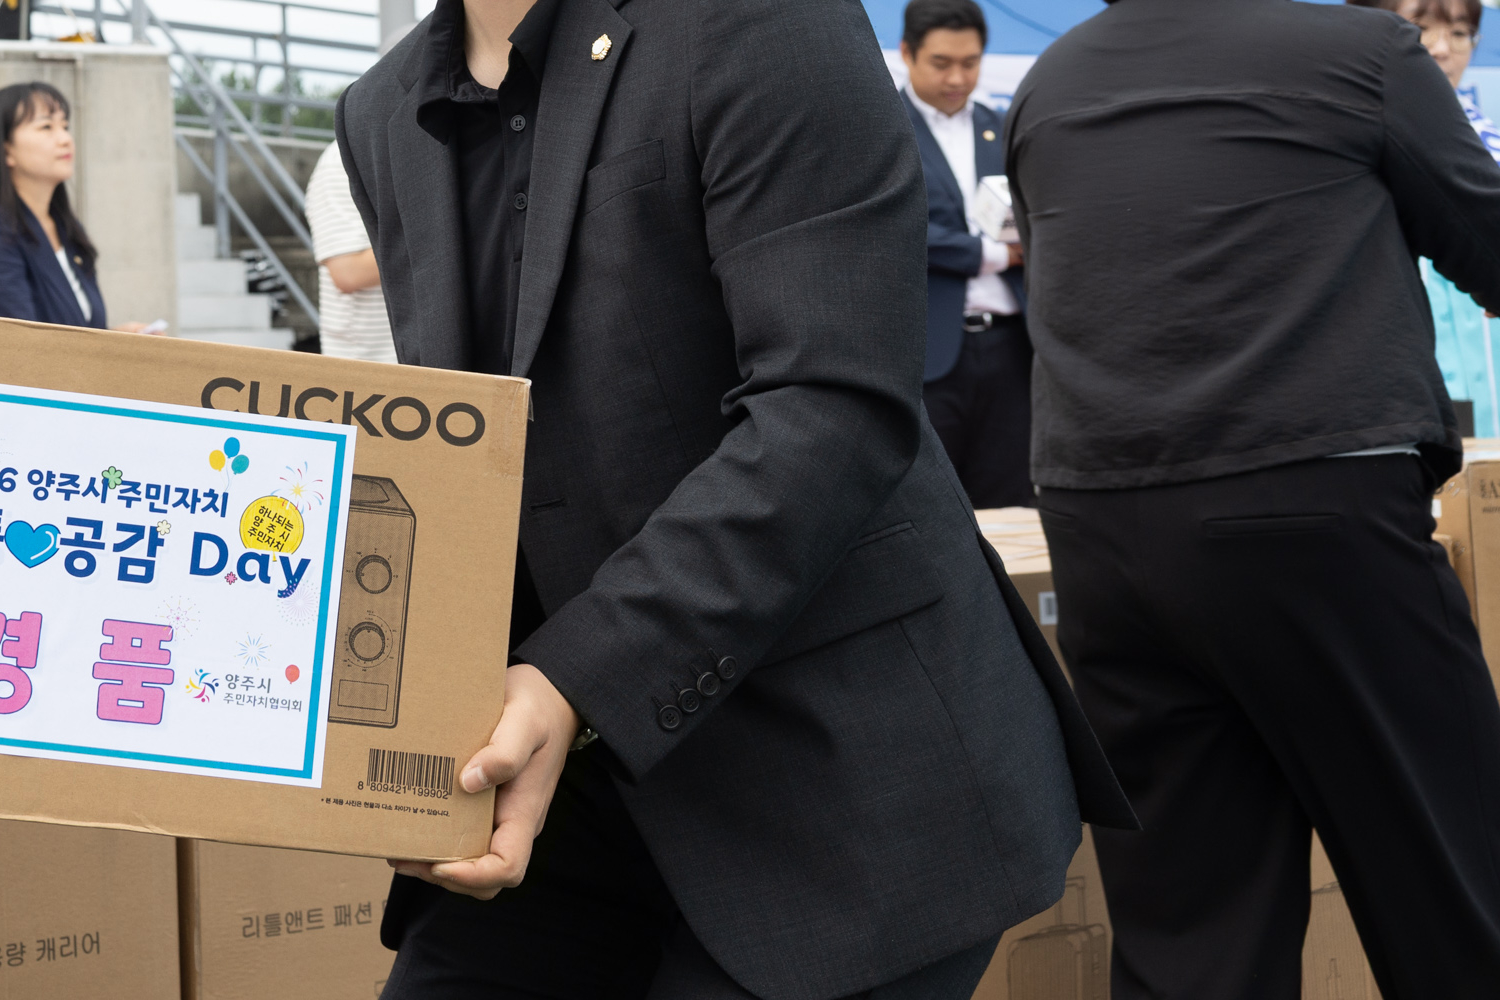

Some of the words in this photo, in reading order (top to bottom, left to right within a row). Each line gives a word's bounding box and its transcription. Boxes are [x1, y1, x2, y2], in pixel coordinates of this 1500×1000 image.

[200, 377, 486, 447] CUCKOO
[27, 469, 108, 504] 양주시
[117, 481, 229, 518] 주민자치
[259, 505, 294, 531] 하나되는
[248, 526, 285, 552] 주민자치
[59, 516, 166, 584] 공감
[189, 531, 311, 599] Day
[225, 674, 271, 694] 양주시
[223, 692, 302, 712] 주민자치협의회
[370, 782, 408, 794] 809421
[412, 787, 449, 800] 199902
[394, 804, 411, 813] 차이가
[242, 907, 325, 939] 리틀앤트
[334, 901, 372, 928] 패션
[35, 931, 101, 962] 캐리어
